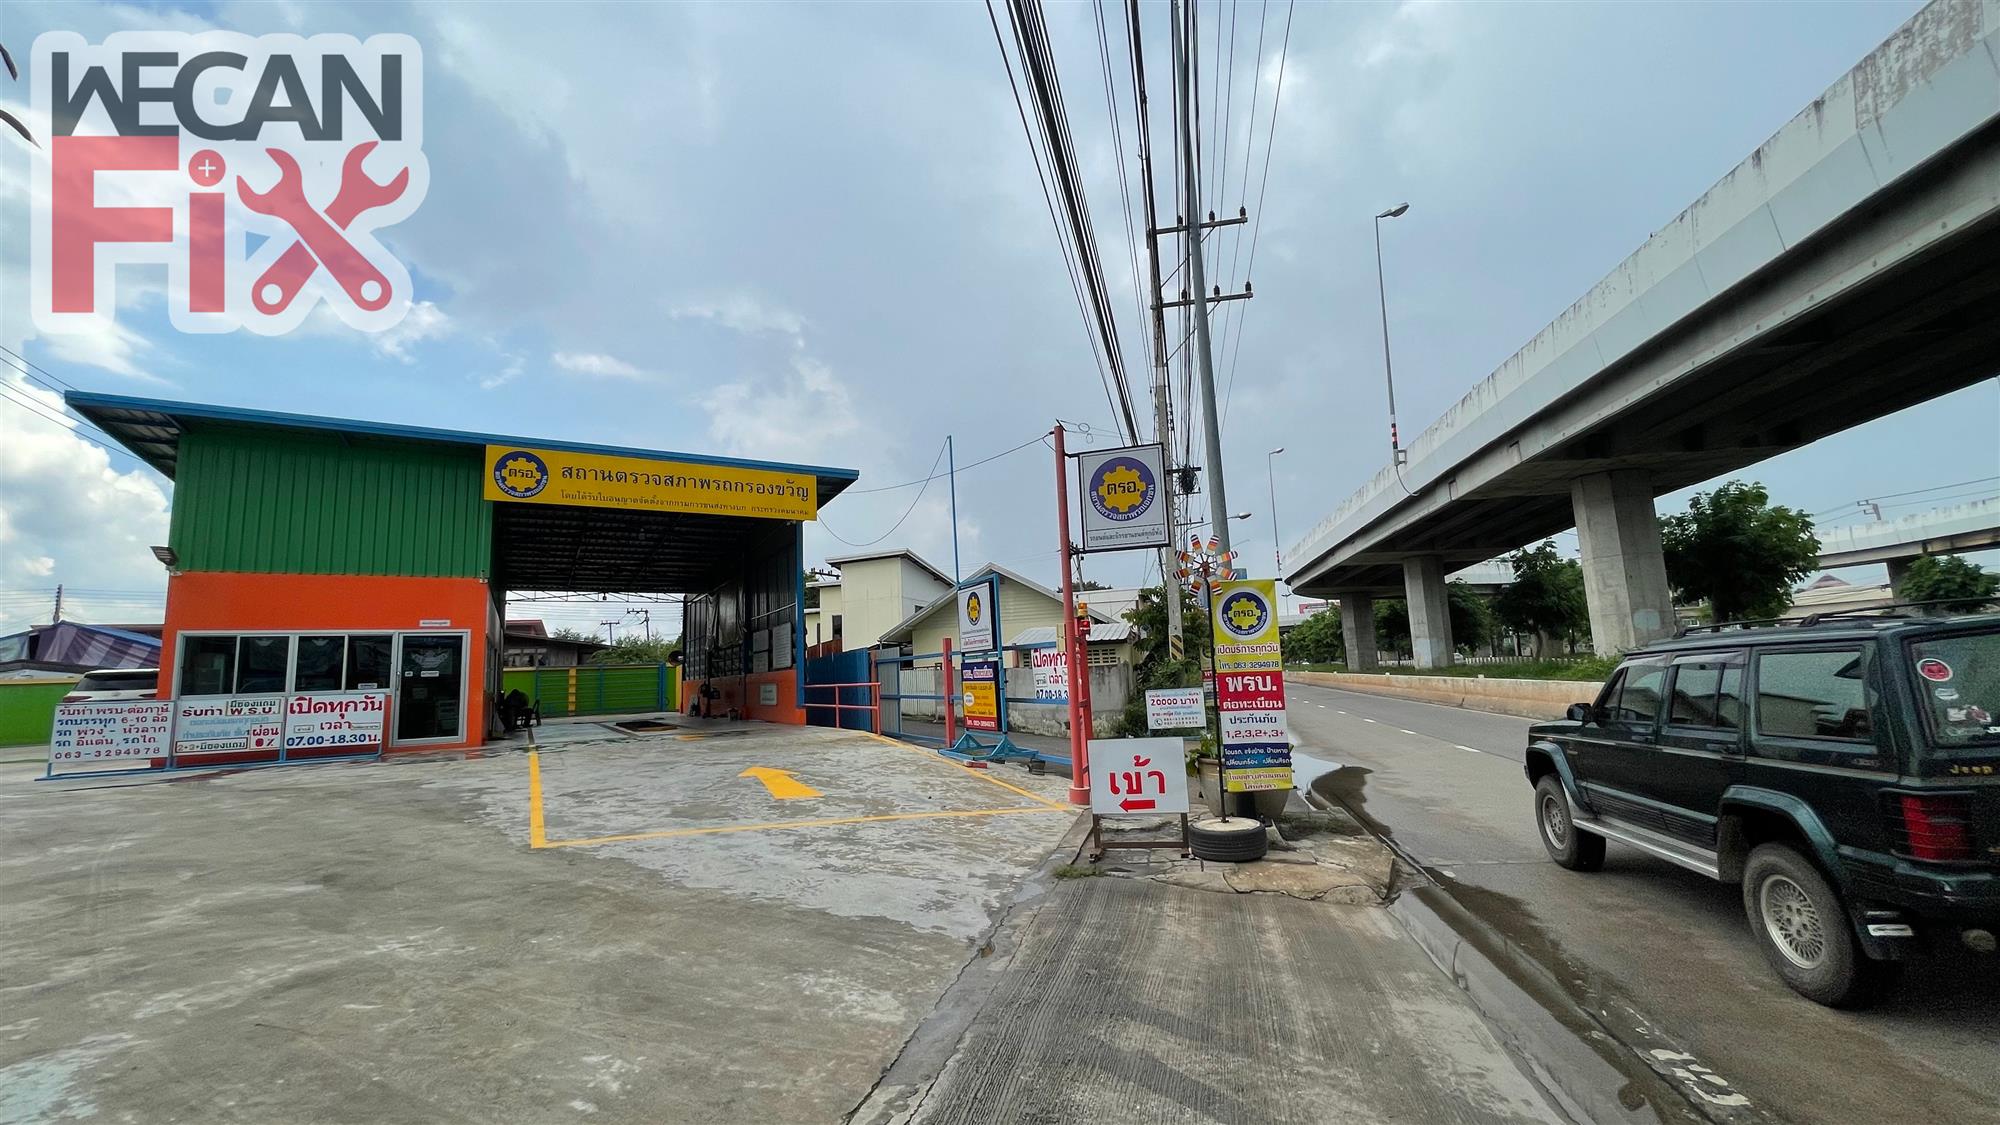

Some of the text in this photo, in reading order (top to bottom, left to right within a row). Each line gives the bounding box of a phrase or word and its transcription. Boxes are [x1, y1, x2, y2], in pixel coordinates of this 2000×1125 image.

[508, 467, 536, 479] ตรอ.
[561, 466, 809, 501] สถานตรวจสภาพรถกรองขวัญ
[1107, 482, 1140, 496] ตรอ.
[1233, 609, 1256, 617] ตรอ.
[1217, 643, 1278, 656] เปิดบริการทุกวัน
[1226, 675, 1277, 692] พรบ.
[289, 695, 382, 719] เปิดทุกวัน
[1151, 698, 1177, 706] 20000
[1223, 697, 1283, 709] ต่อทะเบียน
[59, 706, 93, 716] รับทำ
[182, 705, 276, 717] รับทำ พ.ร.บ.
[57, 716, 116, 727] รถบรรทุก
[1229, 713, 1277, 724] ประกันภัย
[77, 727, 104, 736] พ่วง
[123, 724, 166, 734] หัวลาก
[252, 725, 279, 736] ผ่อน
[320, 721, 352, 730] เวลา
[122, 735, 156, 744] รถไถ
[1226, 729, 1284, 739] 1,2,3,2+,3+
[55, 747, 160, 759] 063-3294978
[1109, 755, 1165, 795] เข้า
